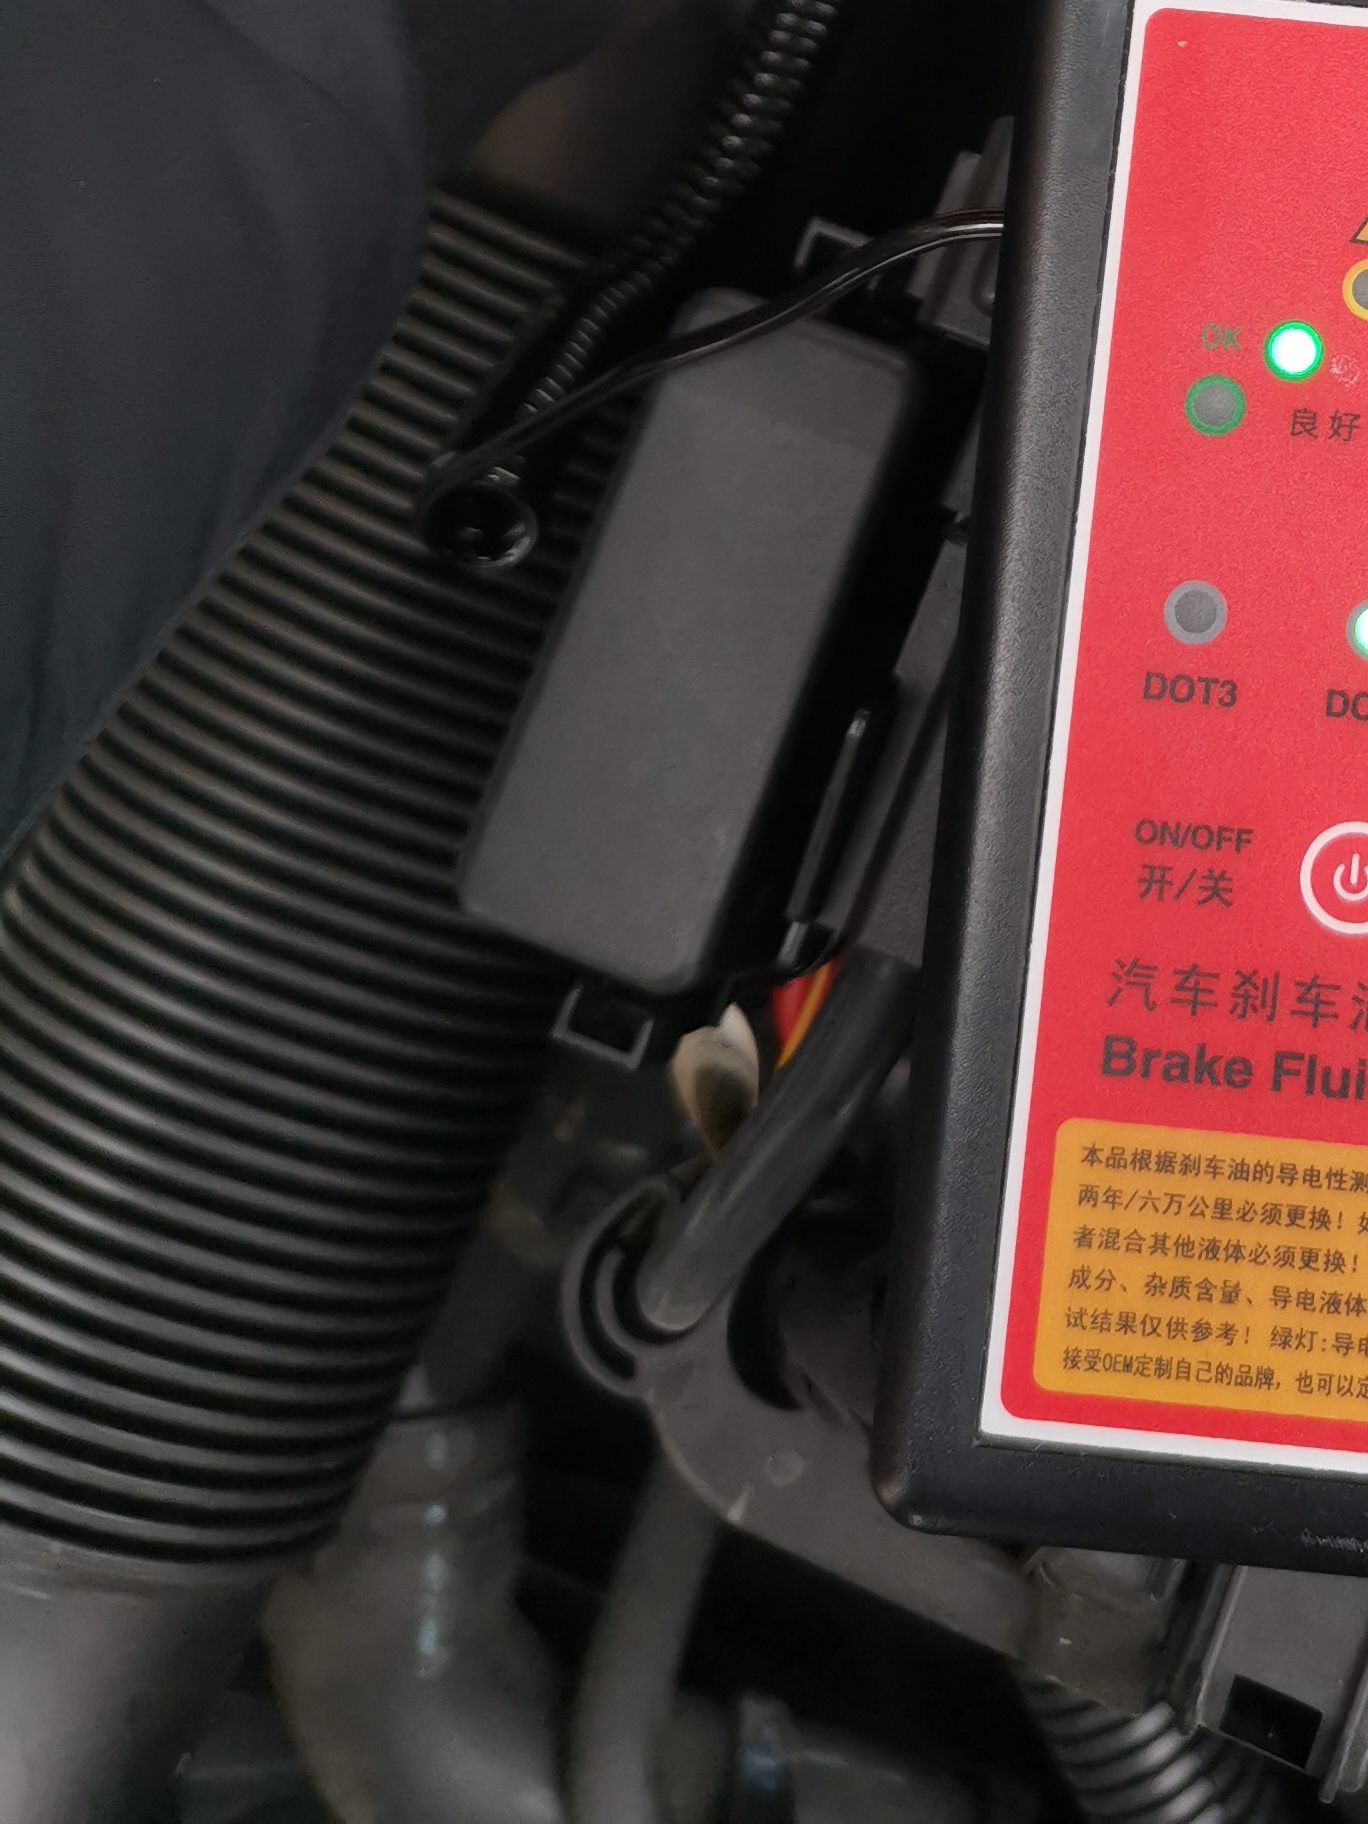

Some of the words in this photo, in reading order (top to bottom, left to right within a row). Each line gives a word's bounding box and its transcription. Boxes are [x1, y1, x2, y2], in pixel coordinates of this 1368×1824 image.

[1200, 323, 1241, 352] OK
[1289, 406, 1361, 442] 良好
[1142, 671, 1238, 709] DOT3
[1134, 819, 1254, 854] ON/OFF
[1137, 863, 1233, 908] 开/关
[1101, 1034, 1253, 1090] Brake
